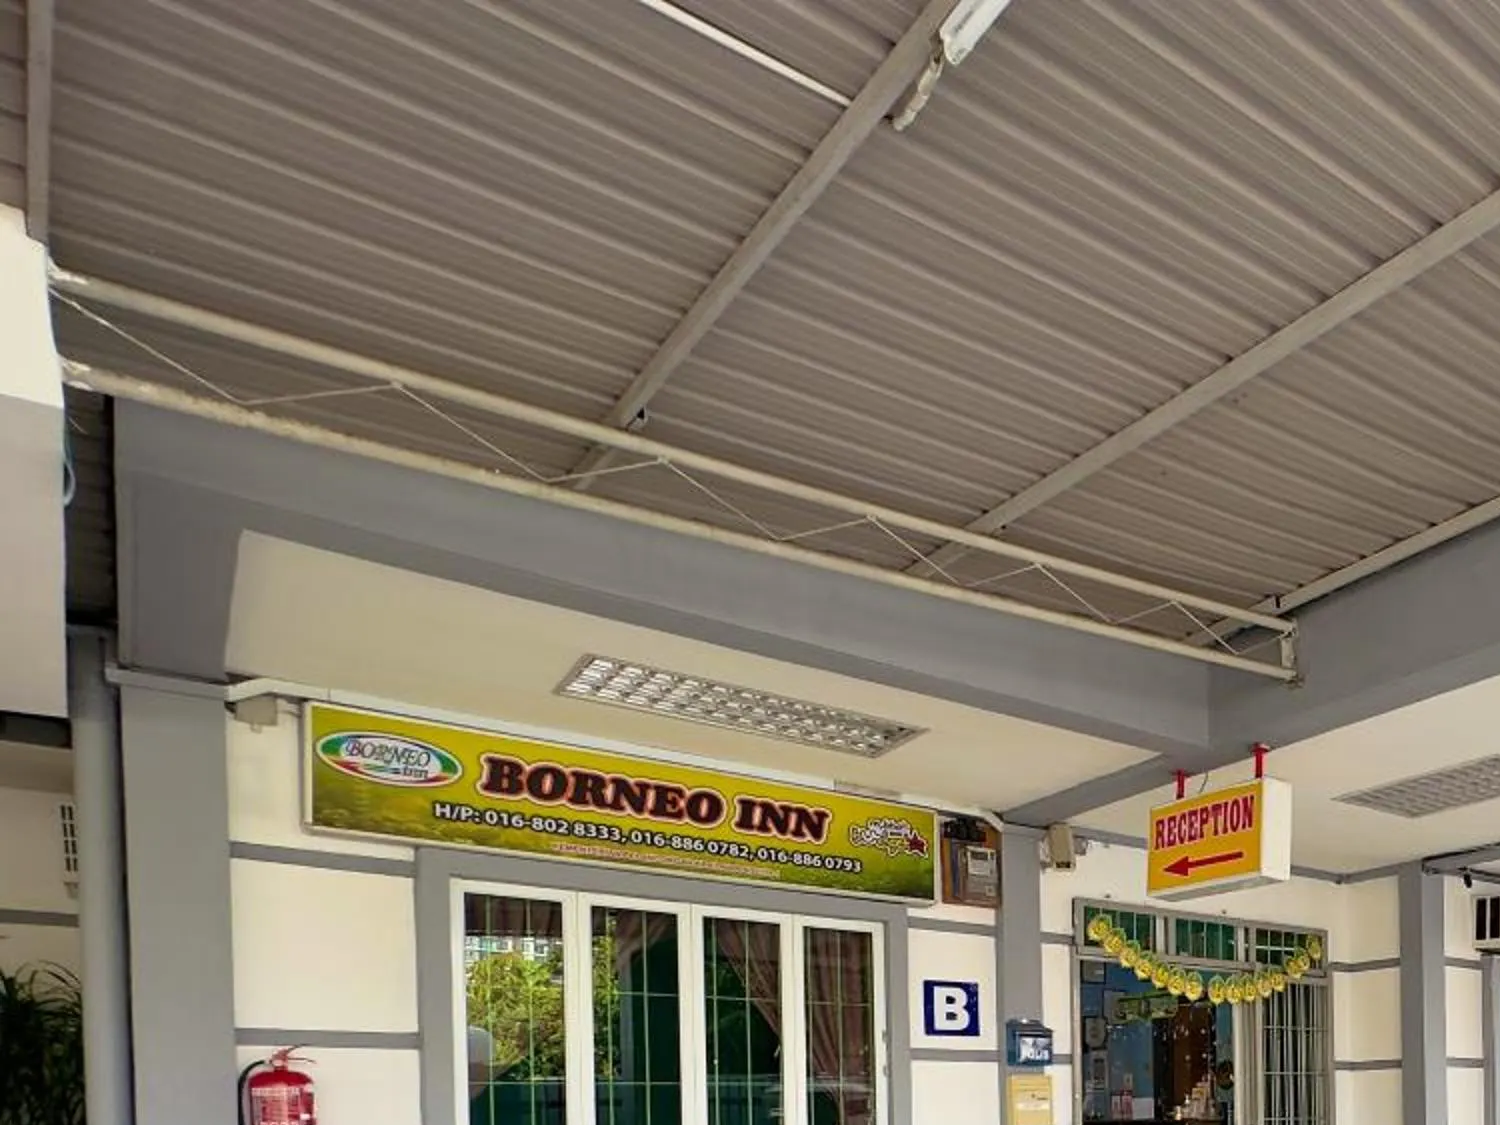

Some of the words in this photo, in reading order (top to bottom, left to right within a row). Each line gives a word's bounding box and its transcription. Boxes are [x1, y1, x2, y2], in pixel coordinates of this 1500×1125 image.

[479, 754, 726, 827] BORNEO
[733, 796, 831, 843] INN
[1154, 794, 1255, 850] RECEPTION
[434, 802, 481, 823] H/P:
[485, 810, 569, 834] 016-802
[573, 822, 627, 844] 8333,
[631, 831, 704, 852] 016-886
[707, 842, 754, 860] 0782,
[757, 849, 822, 868] 016-886
[824, 855, 862, 873] 0793
[933, 985, 971, 1031] B
